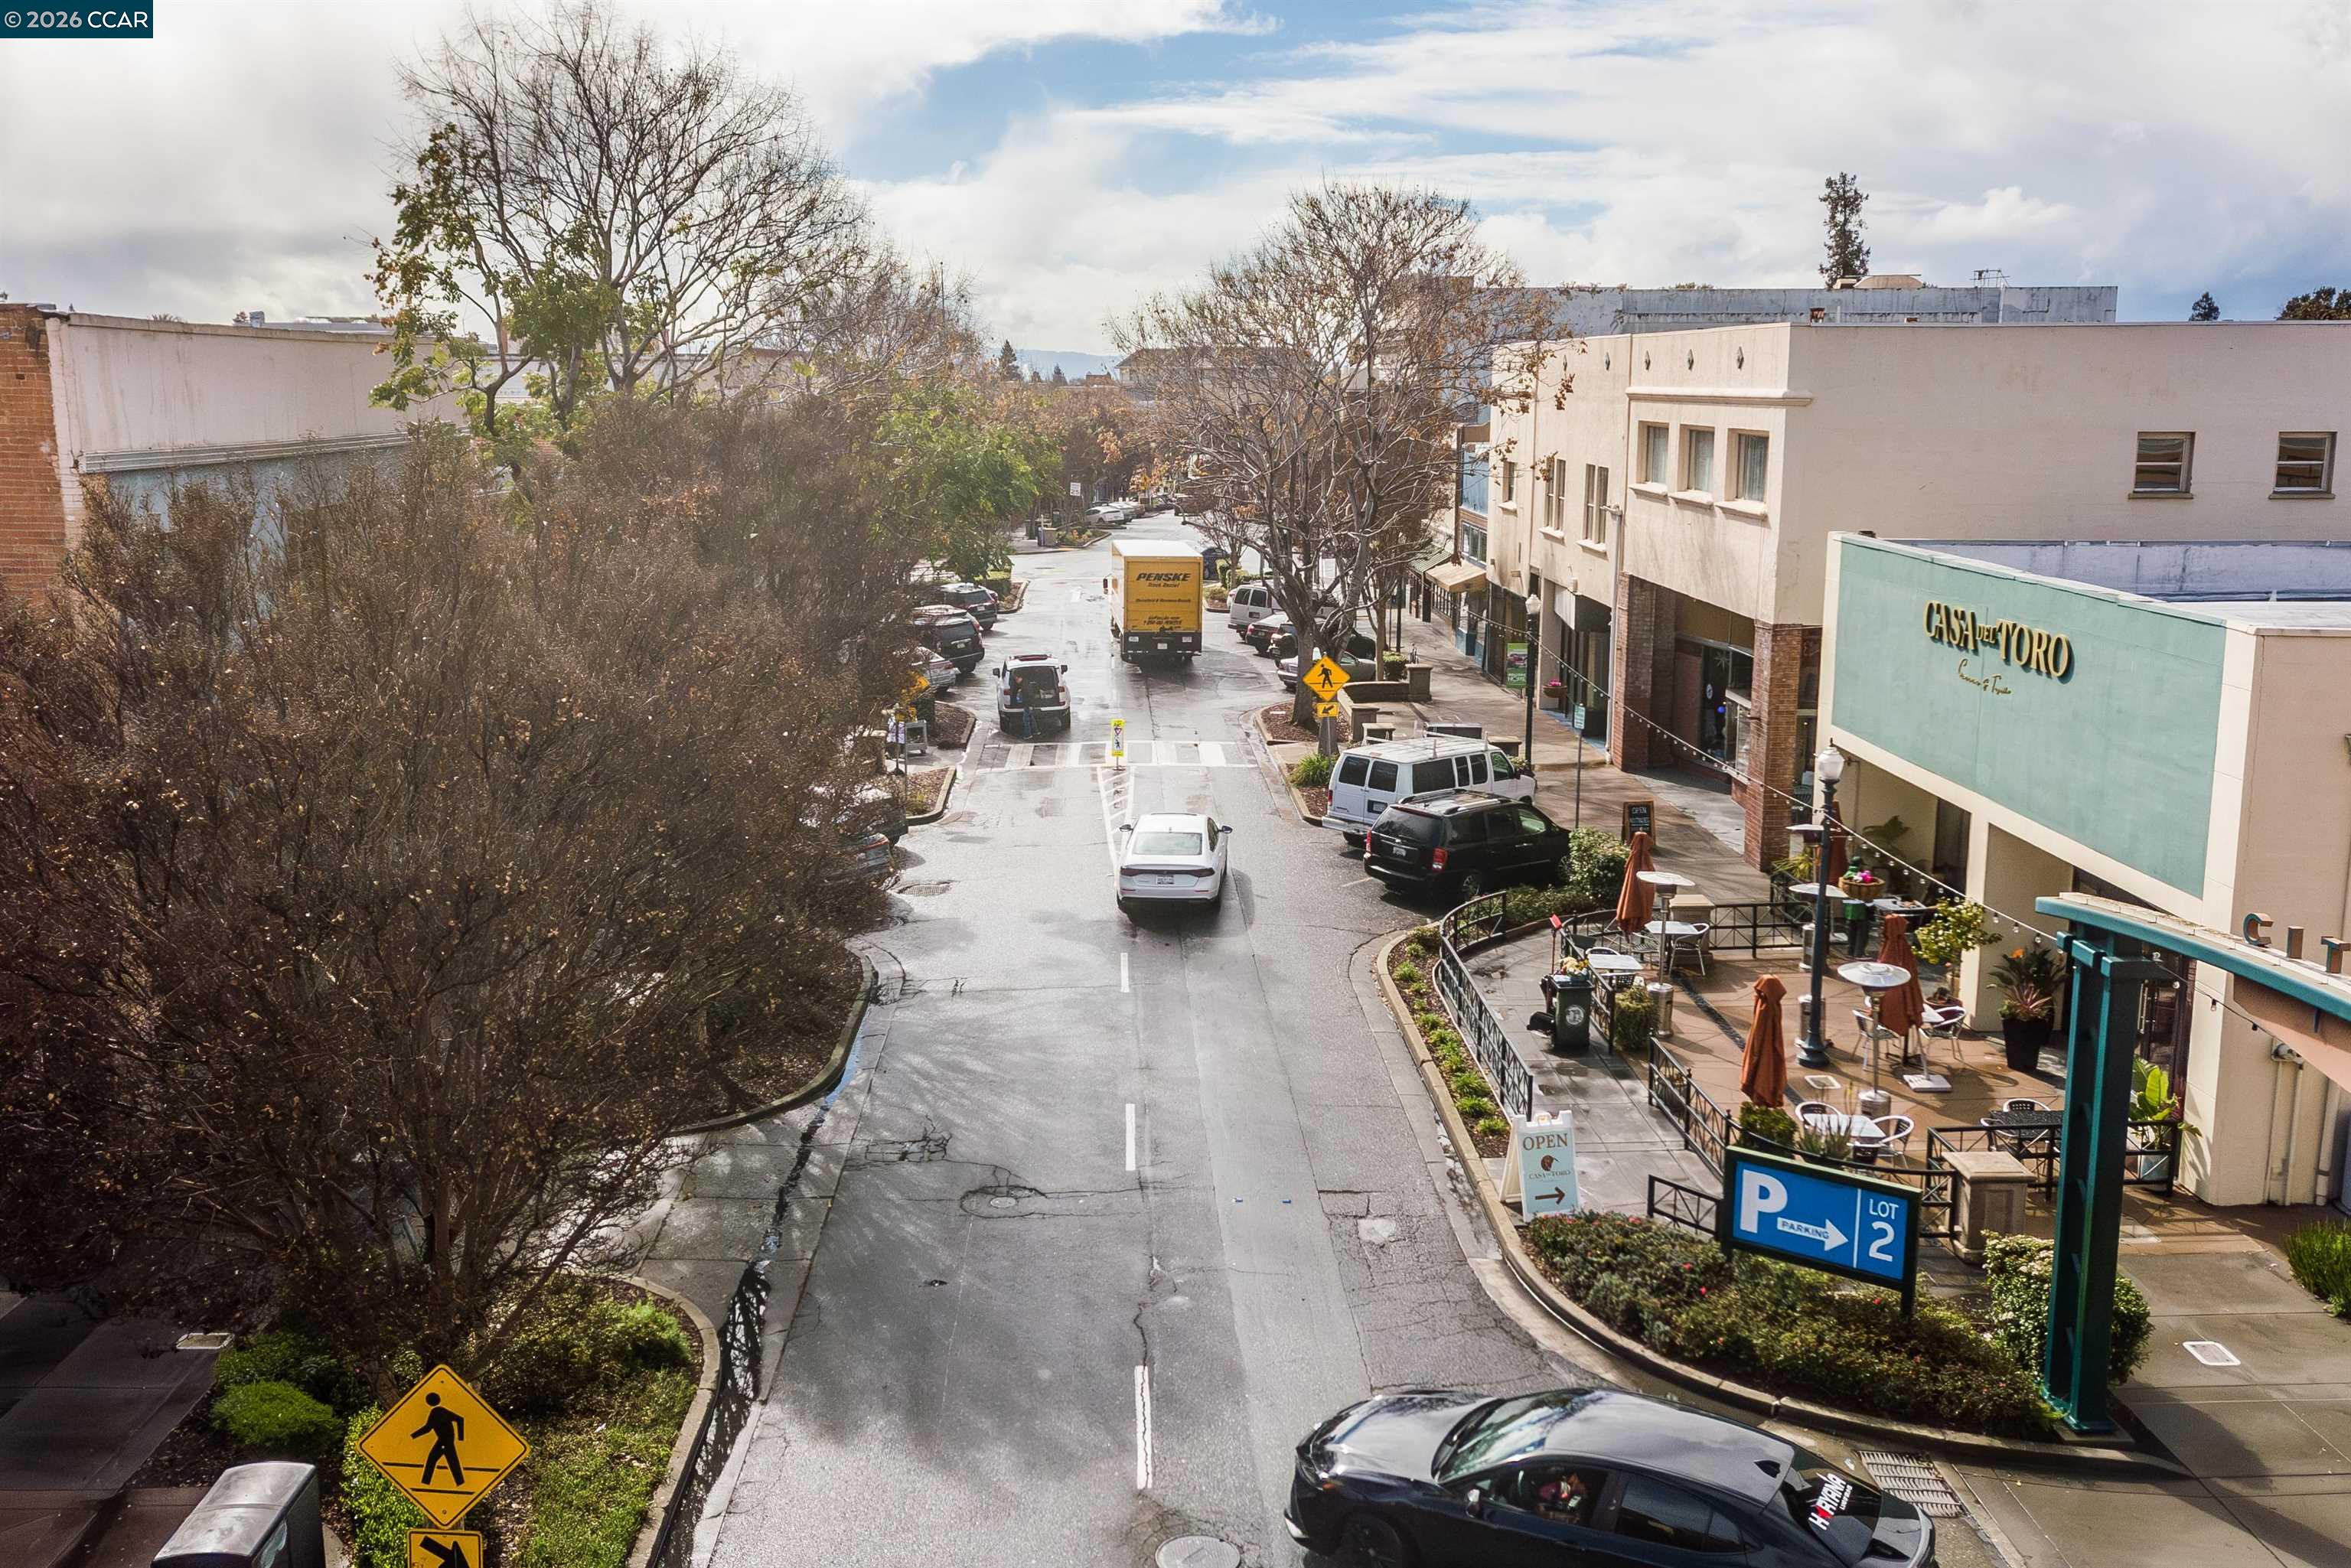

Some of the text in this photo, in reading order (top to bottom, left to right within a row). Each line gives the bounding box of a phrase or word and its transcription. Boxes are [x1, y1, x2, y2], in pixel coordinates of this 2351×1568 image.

[1136, 572, 1192, 582] PENSKE
[1923, 600, 1978, 651] CASA
[1977, 624, 1997, 644] DEL
[1995, 618, 2072, 680] TORO
[1523, 1133, 1568, 1151] OPEN
[1740, 1169, 1789, 1234] P
[1868, 1198, 1899, 1220] LOT
[1780, 1220, 1831, 1240] PARKING
[1868, 1221, 1896, 1263] 2
